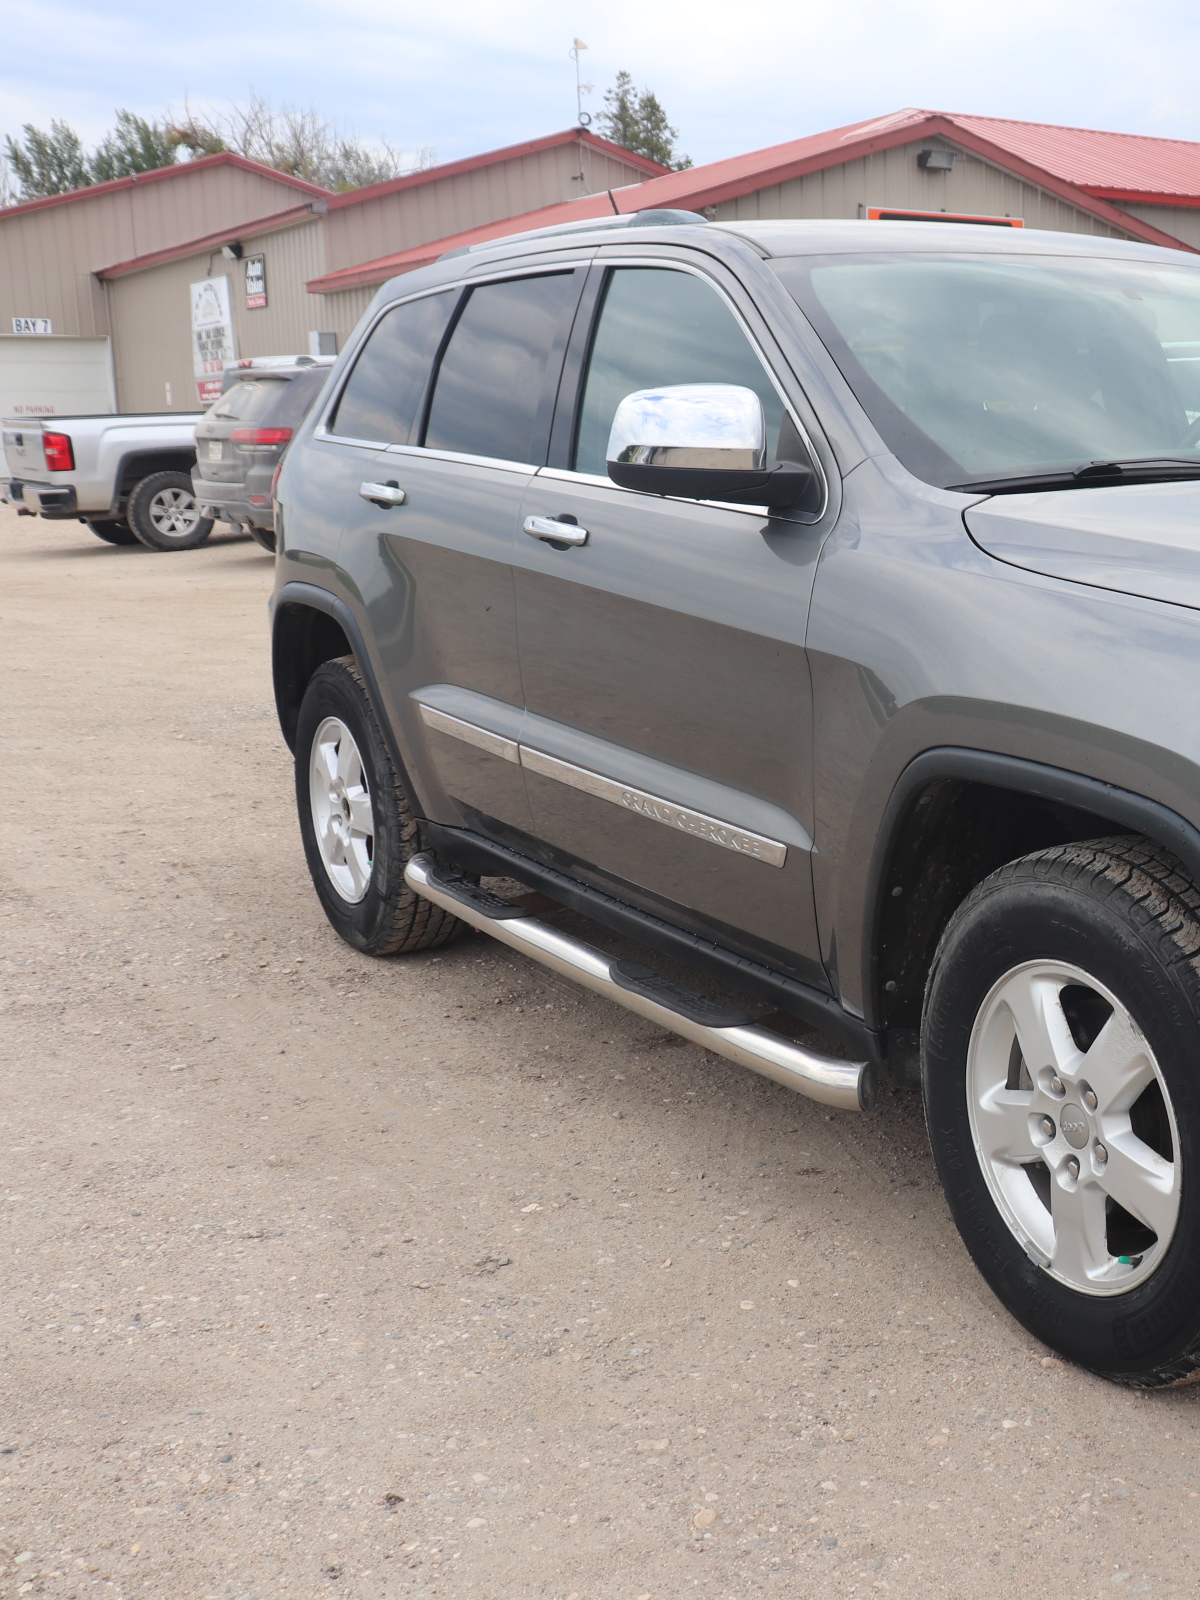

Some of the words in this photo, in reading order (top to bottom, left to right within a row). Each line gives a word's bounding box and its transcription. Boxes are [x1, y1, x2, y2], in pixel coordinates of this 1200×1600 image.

[247, 261, 261, 277] Auto
[246, 277, 263, 294] Value
[15, 319, 36, 332] BAY
[41, 320, 48, 332] 7
[621, 791, 670, 822] GRAND
[677, 812, 761, 858] CHEROKEE
[1063, 1120, 1085, 1133] Jeep
